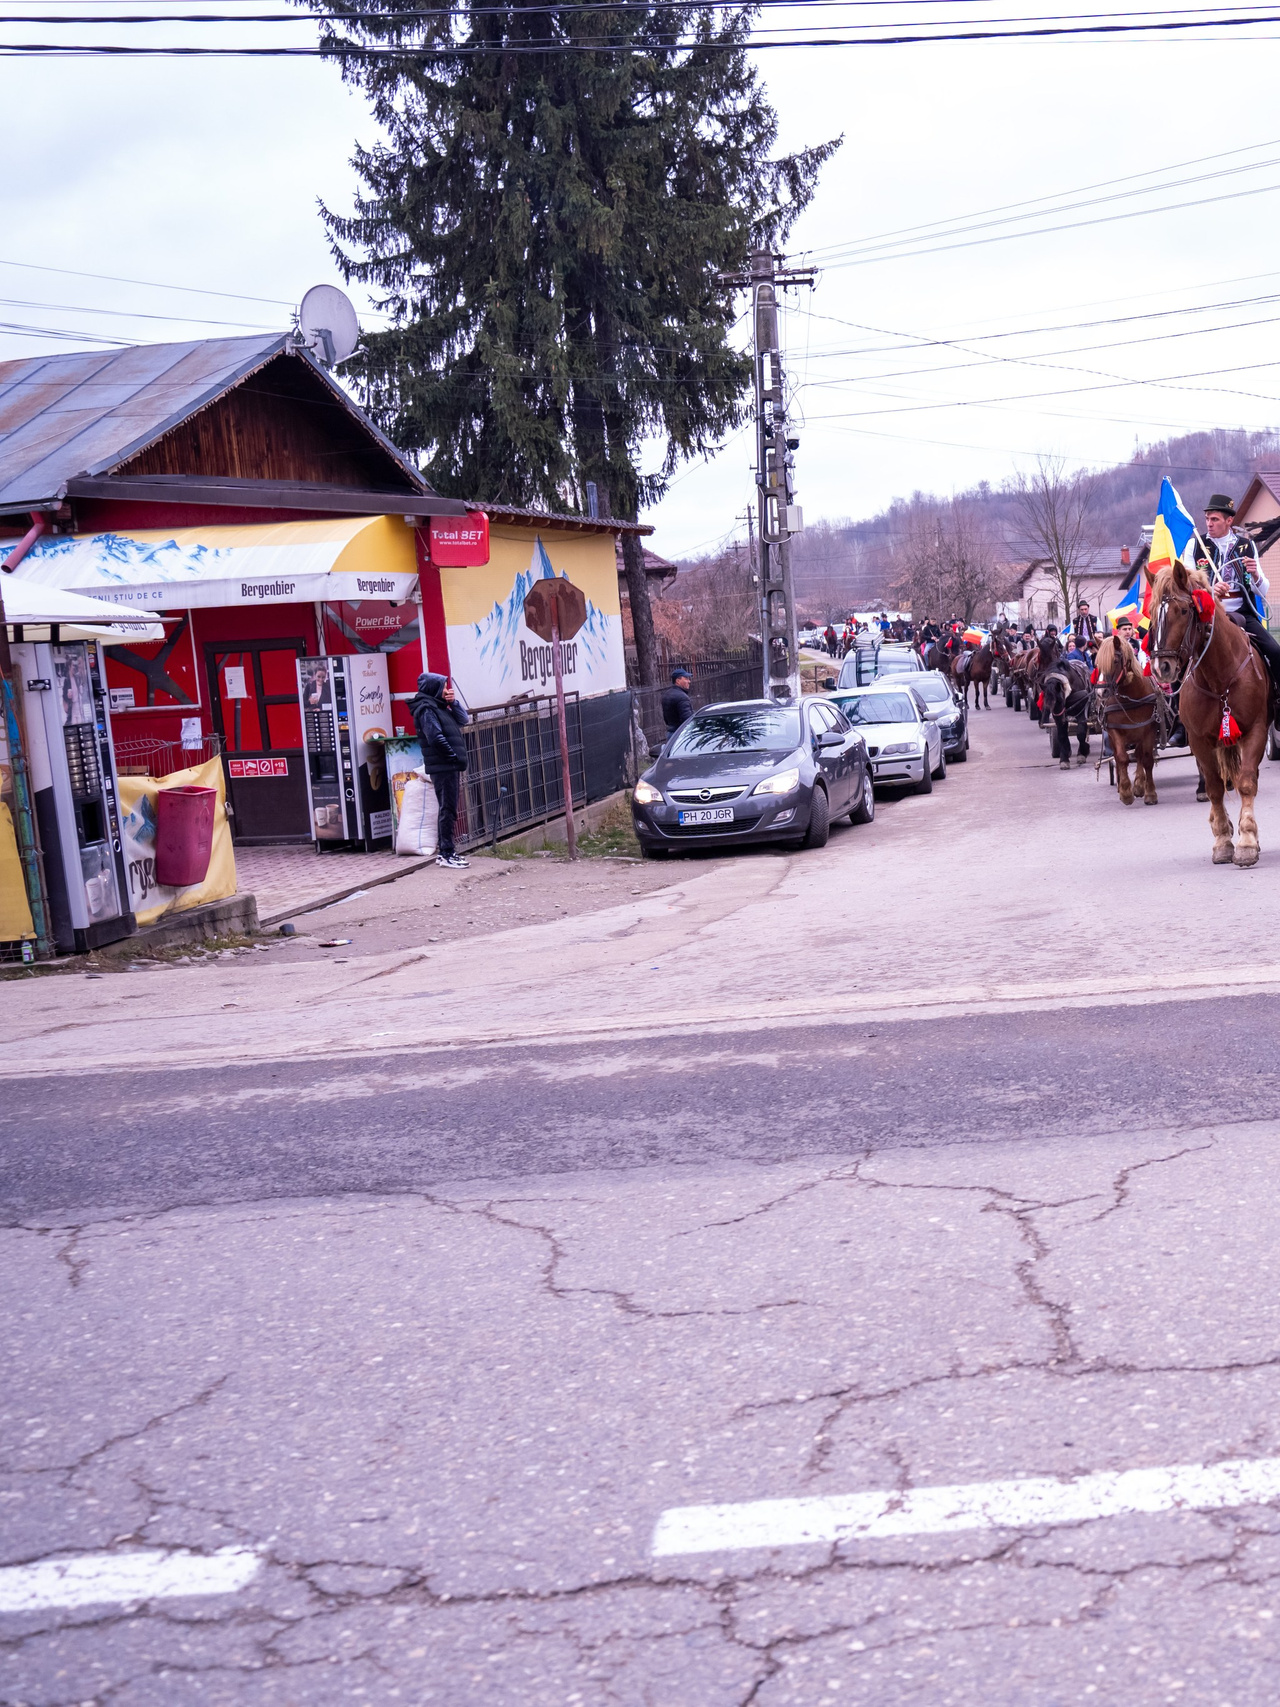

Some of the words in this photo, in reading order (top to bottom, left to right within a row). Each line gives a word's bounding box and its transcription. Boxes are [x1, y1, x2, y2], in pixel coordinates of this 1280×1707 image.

[432, 530, 458, 540] Total
[460, 530, 484, 540] BET
[241, 580, 296, 599] Bergenbier
[356, 577, 396, 594] Bergenbier
[137, 592, 148, 600] DE
[151, 591, 163, 599] CE
[360, 685, 383, 704] Simply
[360, 703, 385, 716] ENJOY
[683, 812, 697, 822] PH
[700, 811, 712, 820] 20
[713, 809, 731, 819] JGR
